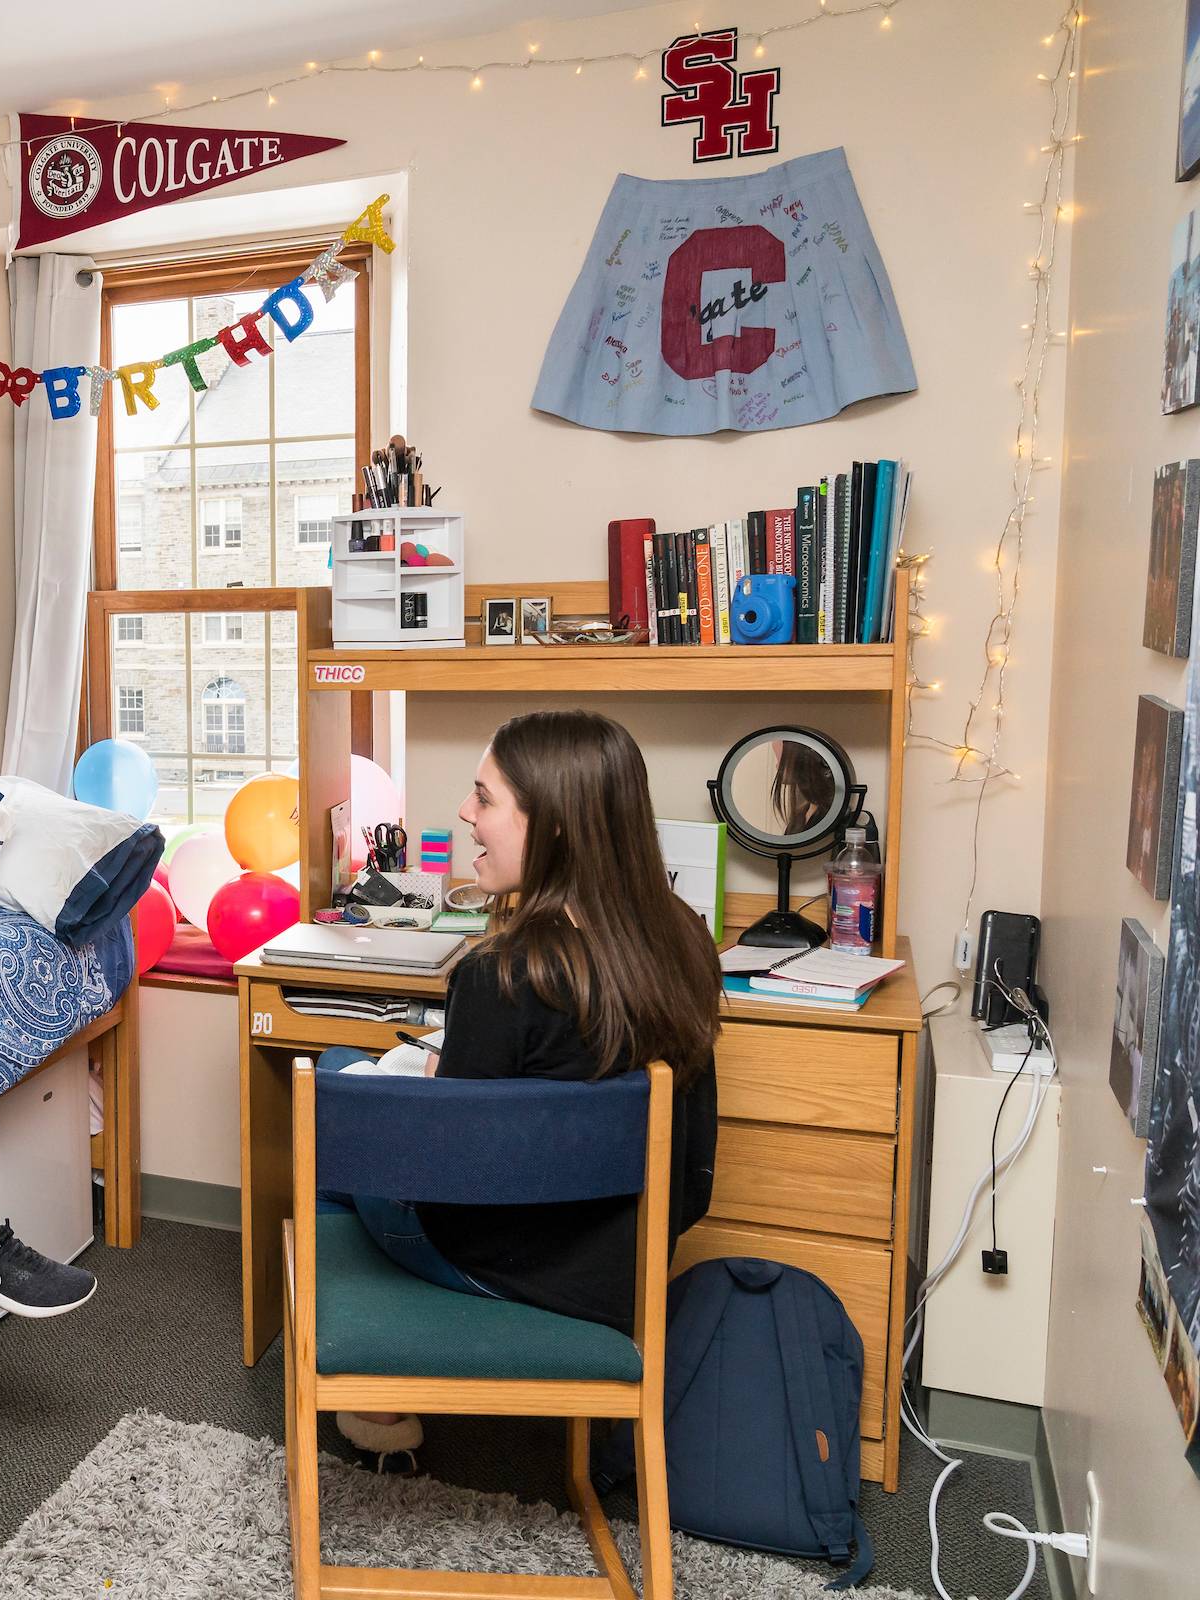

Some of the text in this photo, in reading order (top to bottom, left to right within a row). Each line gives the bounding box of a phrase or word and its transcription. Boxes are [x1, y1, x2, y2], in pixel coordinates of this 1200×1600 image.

[661, 27, 781, 164] SH
[35, 140, 97, 181] COLGATE UNIVERSITY
[113, 137, 281, 203] COLGATE
[41, 199, 75, 213] FOUNDED
[42, 193, 397, 421] BIRTHDAY
[783, 515, 792, 534] THE
[774, 516, 784, 564] ANNOTATED
[783, 534, 792, 553] NEW
[696, 551, 709, 577] ONE
[717, 534, 728, 613] THE ODYSSEY
[801, 533, 812, 609] Microeconomics
[699, 598, 712, 628] GOD
[316, 667, 363, 680] THICC
[791, 985, 817, 995] USED
[252, 1013, 273, 1035] BO
